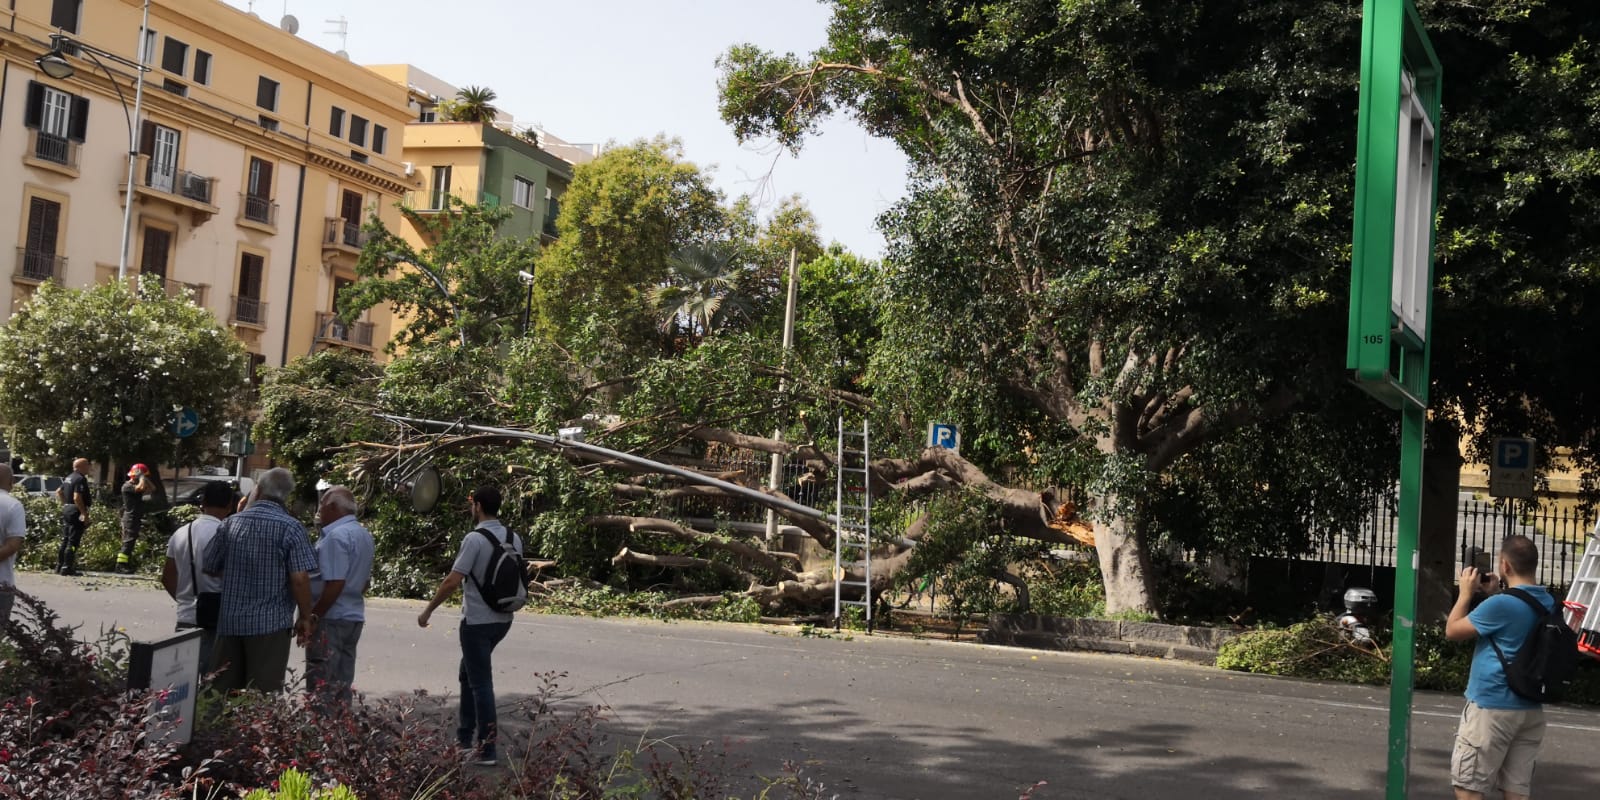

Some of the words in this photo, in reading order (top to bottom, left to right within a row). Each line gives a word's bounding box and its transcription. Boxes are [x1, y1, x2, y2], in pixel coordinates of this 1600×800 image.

[1363, 335, 1383, 344] 105
[937, 427, 951, 445] P
[1504, 444, 1522, 465] P
